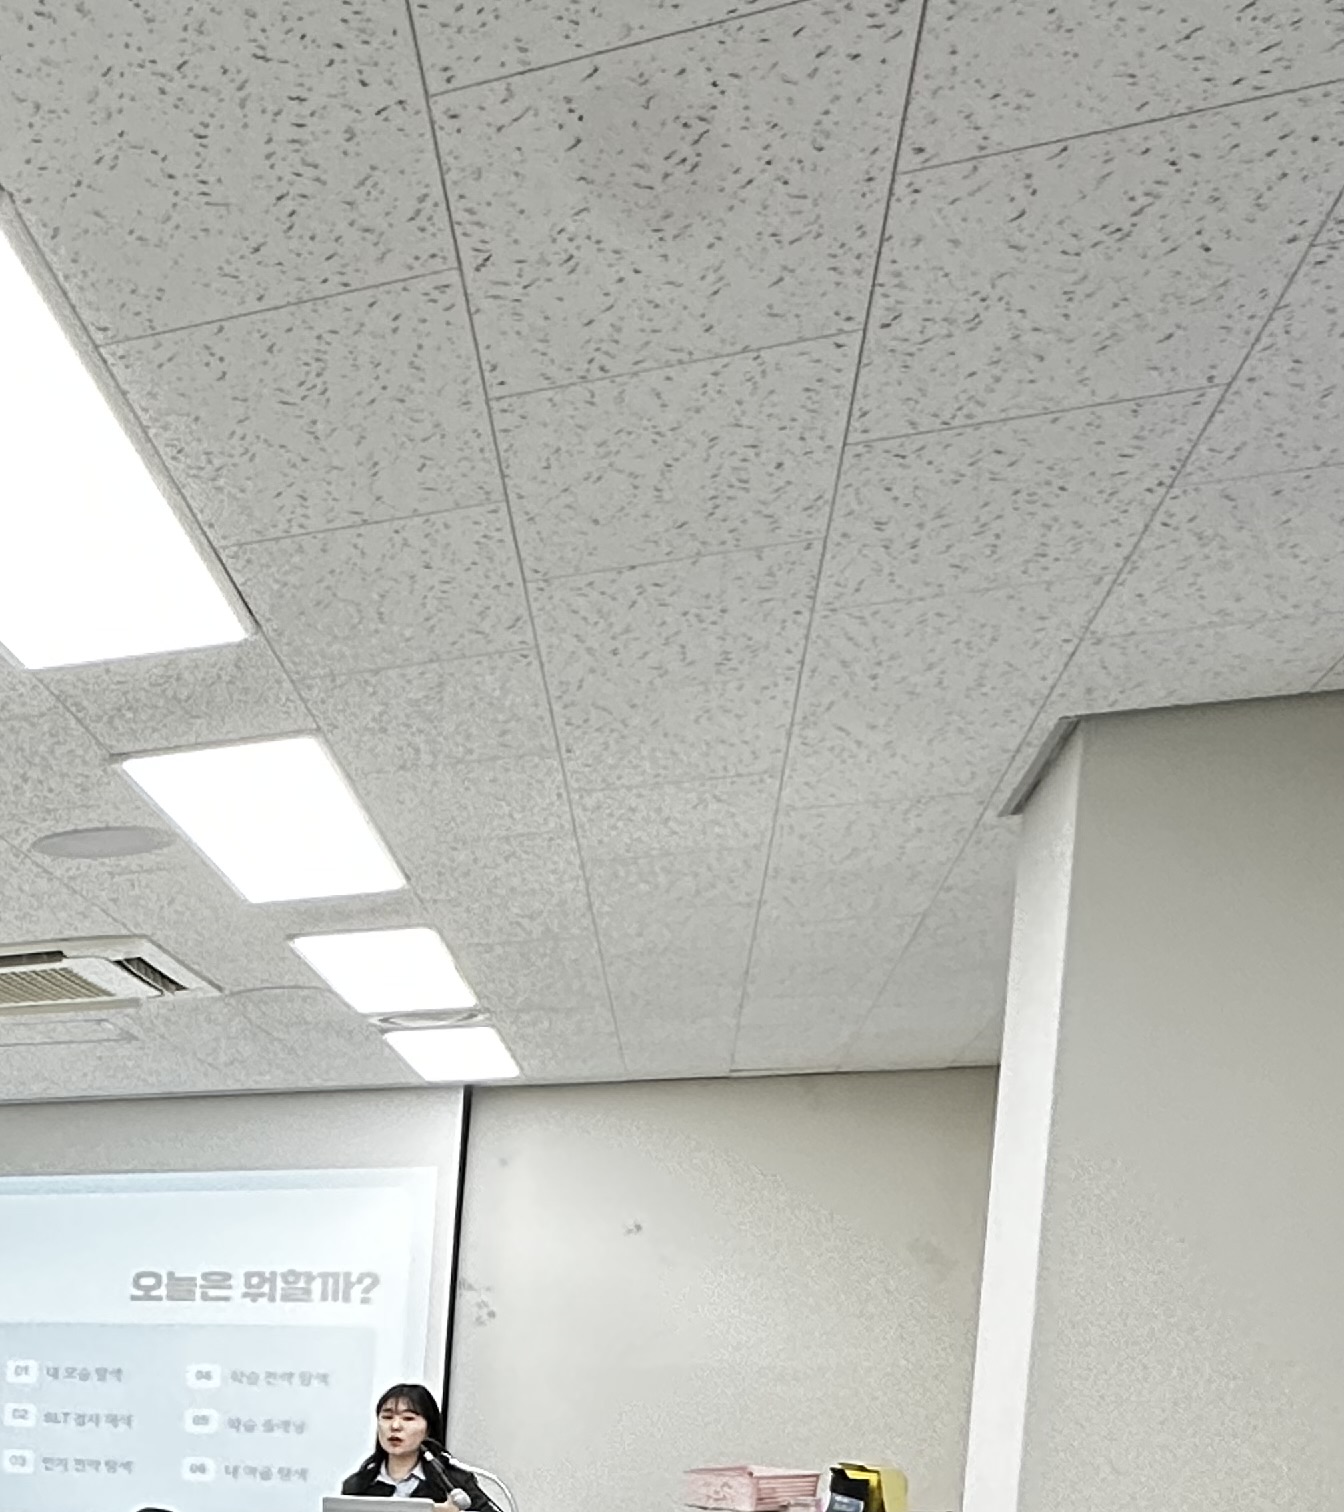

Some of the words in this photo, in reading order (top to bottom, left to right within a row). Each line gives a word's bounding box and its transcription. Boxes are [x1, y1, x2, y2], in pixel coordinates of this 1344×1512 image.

[130, 1269, 234, 1302] 오늘은
[241, 1268, 381, 1304] 뭐할까?
[14, 1364, 30, 1377] 01
[12, 1408, 29, 1420] 02
